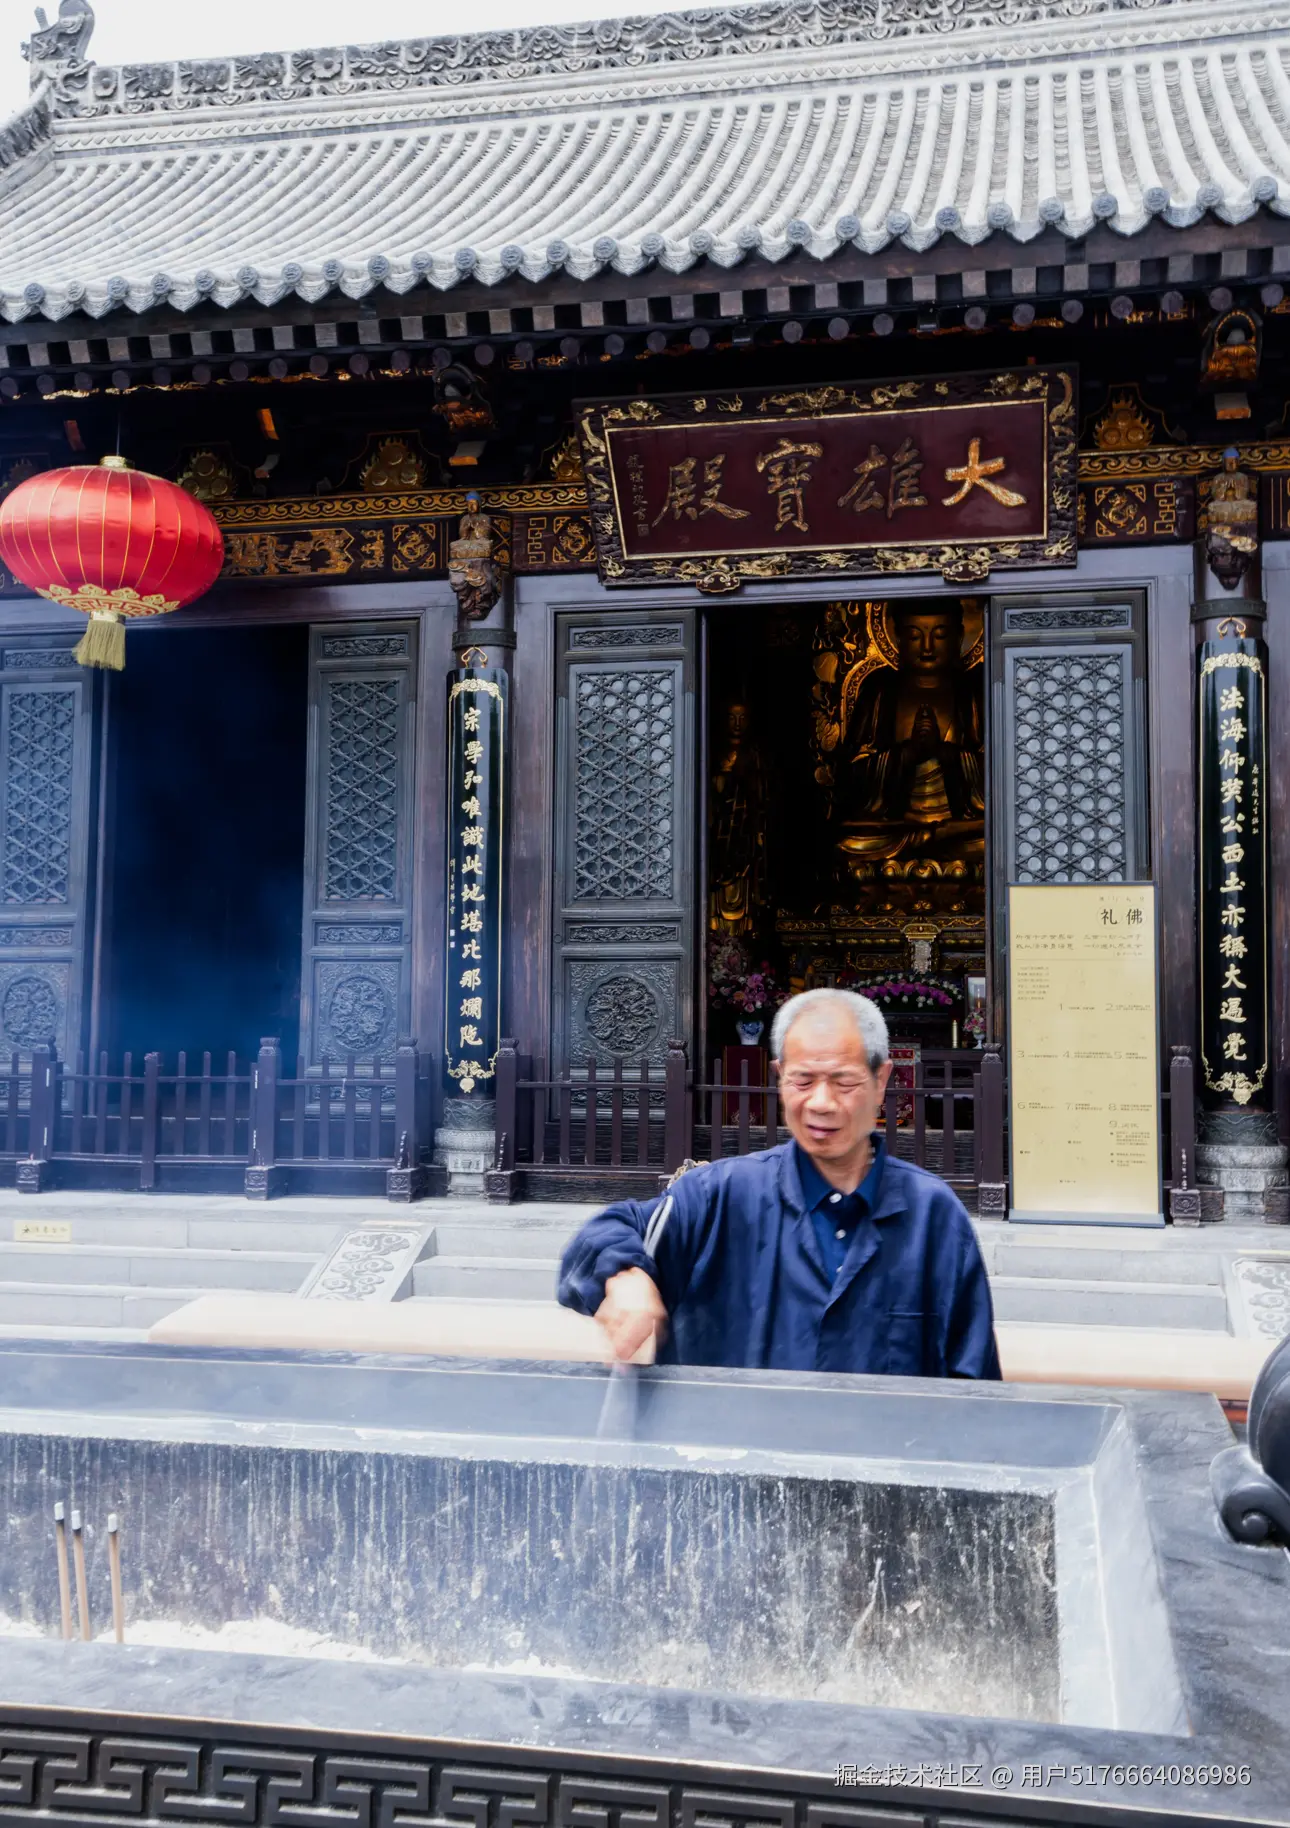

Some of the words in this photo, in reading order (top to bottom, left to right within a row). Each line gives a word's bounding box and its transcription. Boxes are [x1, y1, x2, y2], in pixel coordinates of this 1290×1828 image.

[652, 437, 1028, 533] 大雄寶殿
[1100, 908, 1143, 925] 礼佛
